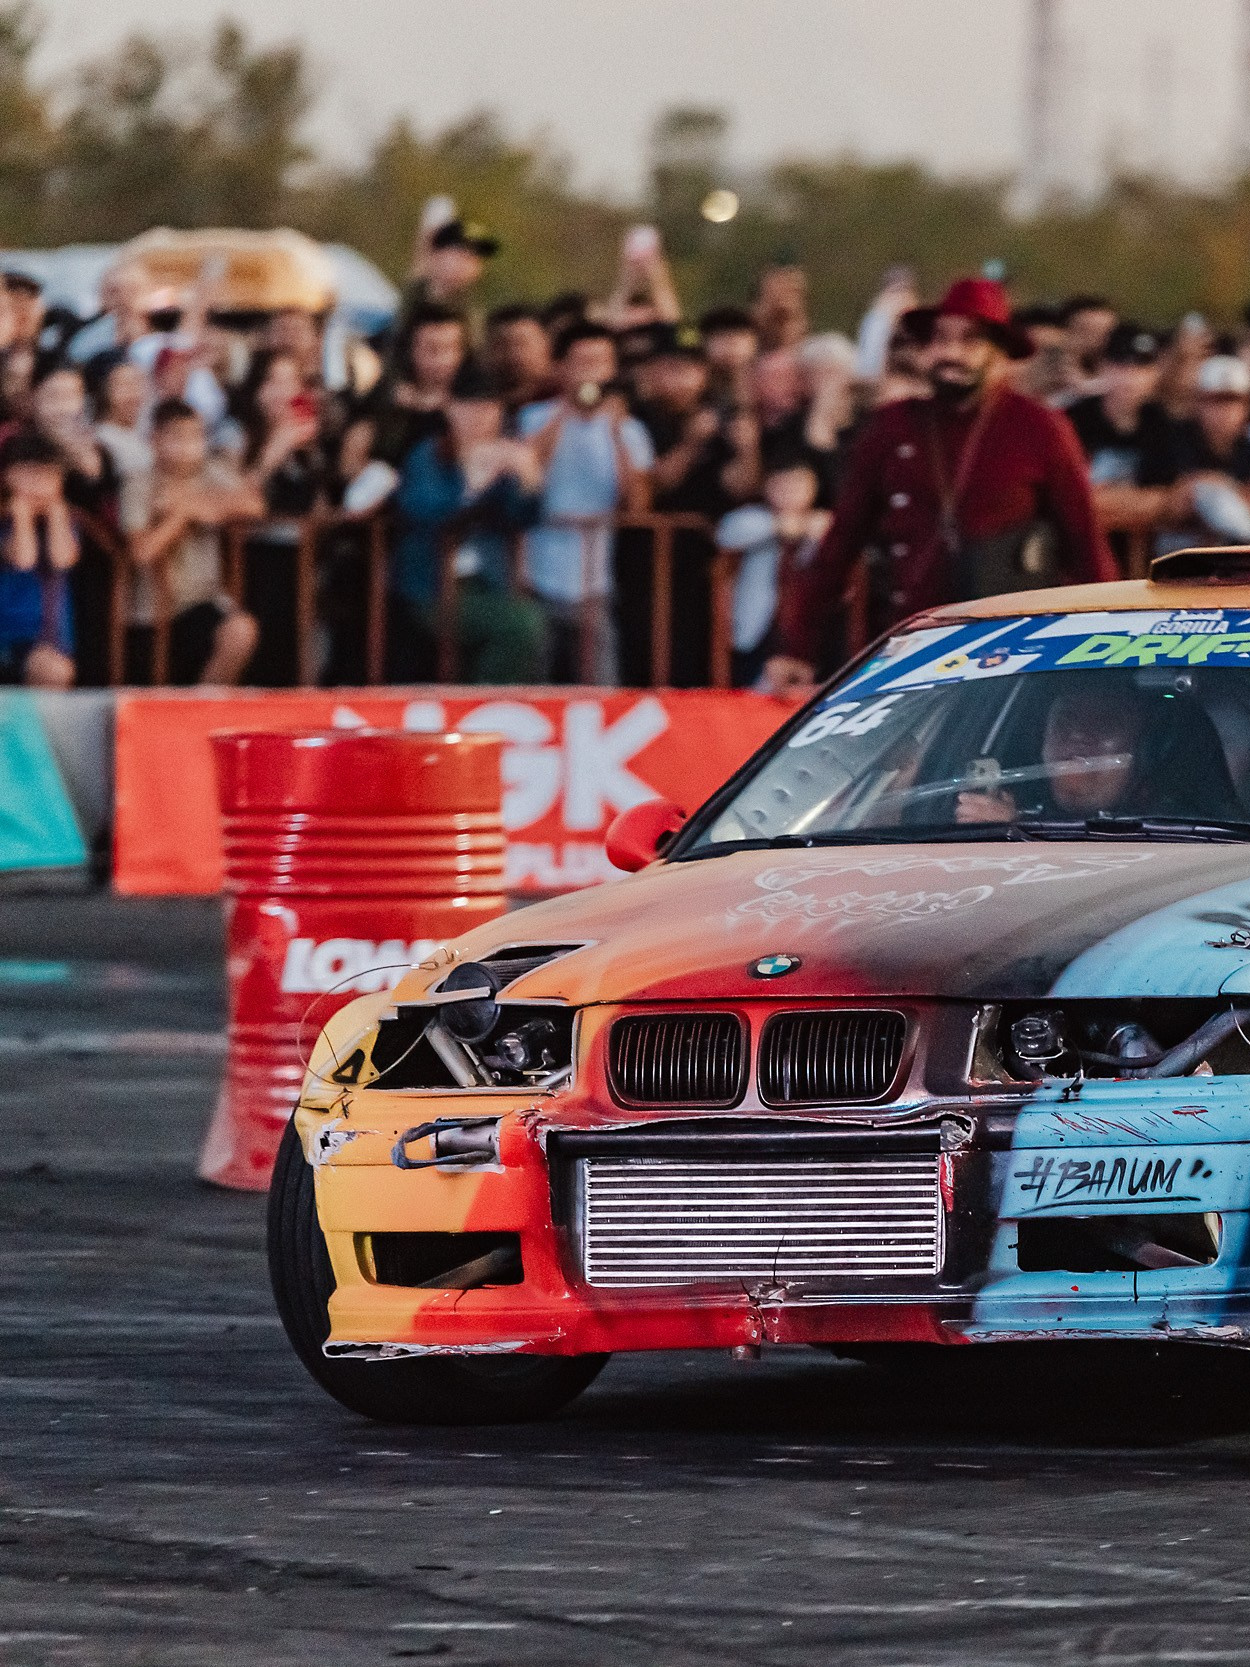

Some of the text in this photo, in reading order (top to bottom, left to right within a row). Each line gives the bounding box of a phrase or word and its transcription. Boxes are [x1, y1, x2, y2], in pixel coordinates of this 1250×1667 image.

[1151, 621, 1230, 634] GORILLA
[788, 693, 905, 748] 64
[332, 696, 669, 832] GK
